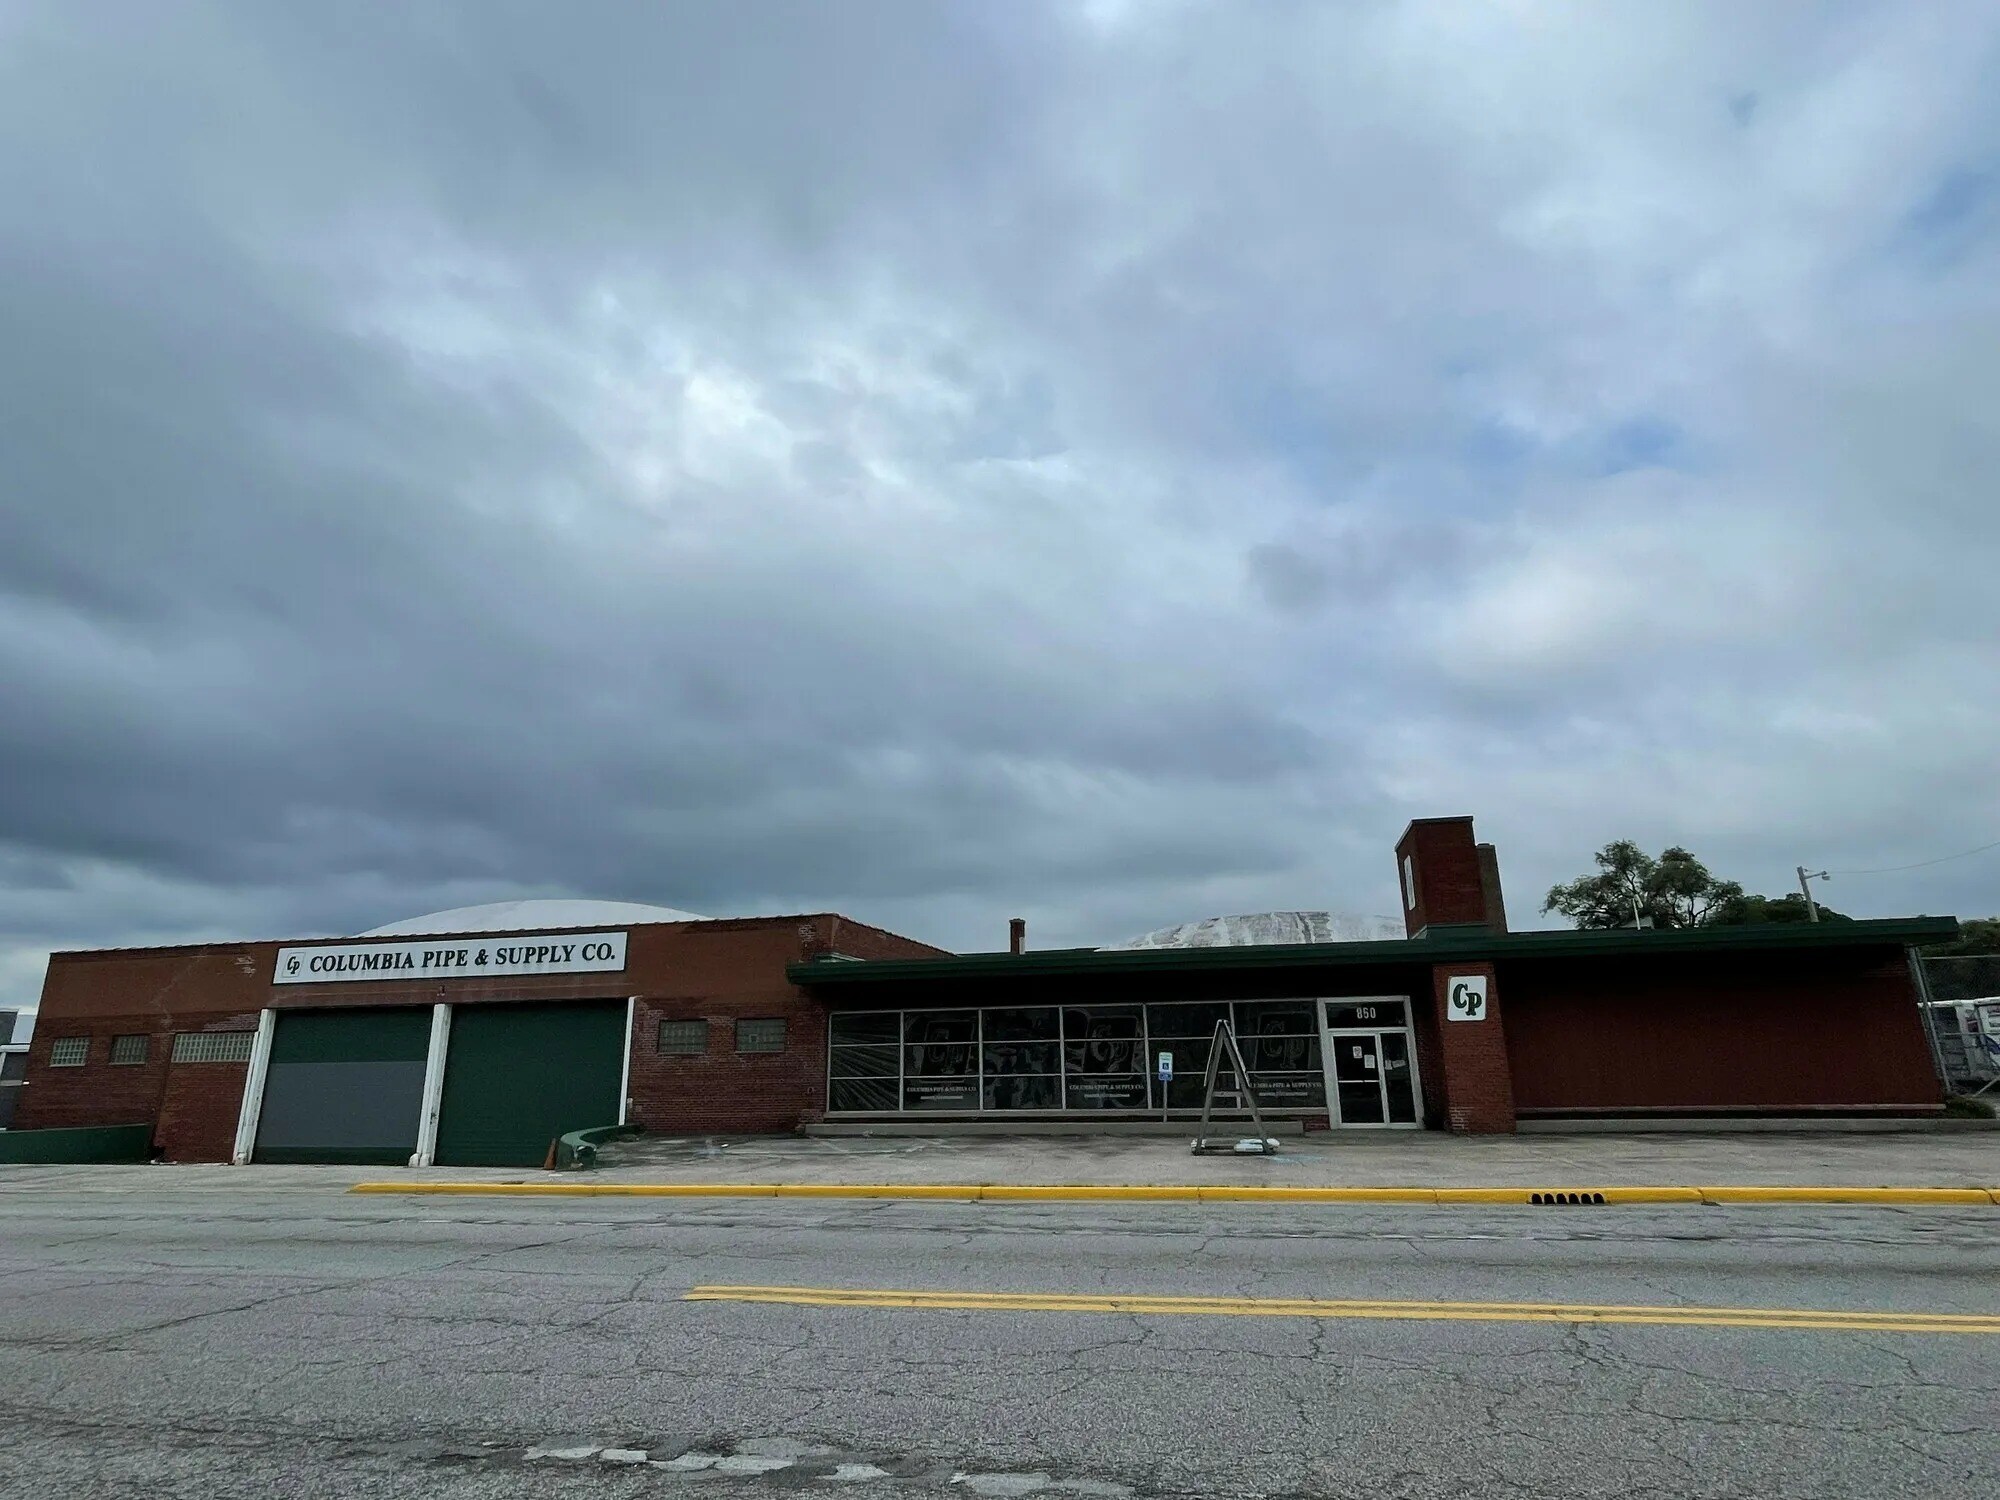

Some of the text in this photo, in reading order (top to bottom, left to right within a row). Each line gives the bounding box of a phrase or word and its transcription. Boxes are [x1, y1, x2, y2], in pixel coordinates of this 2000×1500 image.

[309, 952, 414, 973] COLUMBIA
[421, 948, 468, 968] PIPE
[474, 947, 489, 966] &
[495, 944, 576, 966] SUPPLY
[581, 941, 616, 961] CO.
[1452, 983, 1482, 1016] CP
